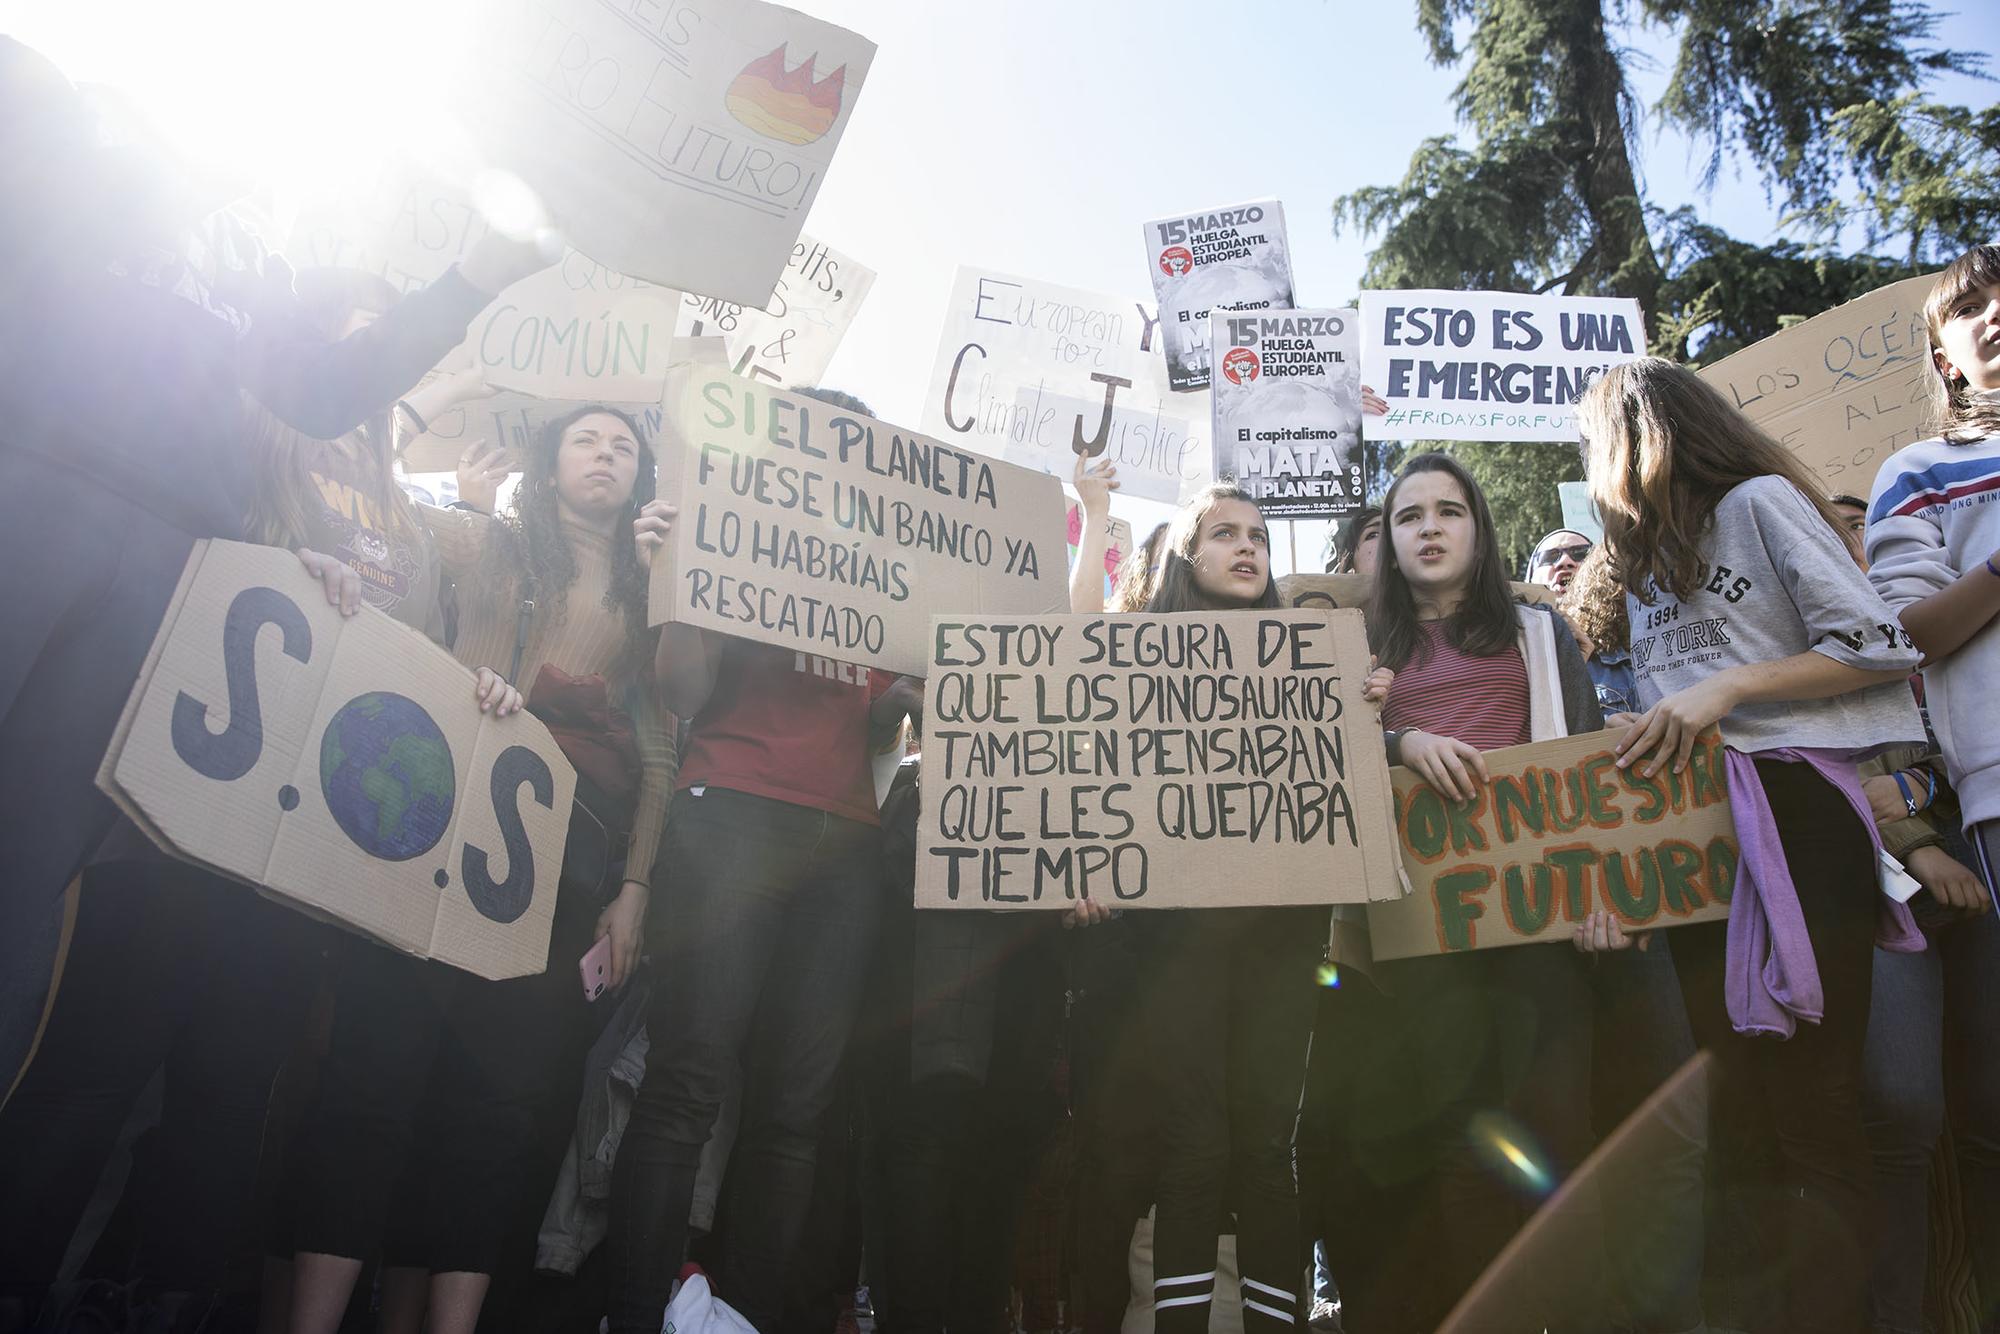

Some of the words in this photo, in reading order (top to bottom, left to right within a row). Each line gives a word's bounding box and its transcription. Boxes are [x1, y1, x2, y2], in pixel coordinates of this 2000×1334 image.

[625, 56, 817, 211] FUTURO!
[1157, 219, 1188, 246] 15
[1187, 206, 1264, 233] MARZO
[1190, 228, 1239, 245] HUELGA
[1191, 234, 1269, 256] ESTUDIANTIL
[1193, 248, 1252, 267] EUROPEA
[974, 277, 1123, 346] European
[1178, 310, 1191, 323] El
[1227, 318, 1258, 346] 15
[1261, 316, 1345, 338] MARZO
[1383, 306, 1476, 348] ESTO
[1492, 309, 1544, 351] ES
[1559, 311, 1635, 354] UNA
[480, 304, 650, 378] COMÚN
[1261, 339, 1316, 351] HUELGA
[1262, 350, 1346, 365] ESTUDIANTIL
[1729, 366, 1800, 409] LOS
[1824, 310, 1927, 373] OCÉA
[1262, 364, 1326, 378] EUROPEA
[1385, 358, 1609, 405] EMERGENC
[944, 342, 1056, 449] Climate
[1071, 371, 1202, 481] Justice
[703, 381, 755, 434] SI
[767, 397, 828, 460] EL
[829, 416, 997, 509] PLANETA
[1238, 428, 1251, 441] El
[1255, 428, 1338, 445] capitalismo
[1238, 445, 1344, 479] MATA
[700, 442, 823, 517] FUESE
[833, 480, 885, 537] UN
[890, 501, 992, 566] BANCO
[1004, 535, 1040, 580] YA
[1261, 479, 1346, 499] PLANETA
[695, 503, 741, 558] LO
[751, 518, 910, 602] HABRÍAIS
[686, 568, 885, 655] RESCATADO
[1647, 602, 1679, 629] 1994
[934, 622, 1064, 668] ESTOY
[1080, 619, 1233, 671] SEGURA
[1257, 619, 1336, 671] DE
[1661, 617, 1731, 657] YORK
[1687, 651, 1722, 665] FOREVER
[935, 672, 1022, 724] QUE
[1034, 672, 1118, 724] LOS
[1128, 672, 1343, 724] DINOSAURIOS
[934, 728, 1119, 780] TAMBIEN
[1127, 724, 1347, 782] PENSABAN
[939, 783, 1026, 842] QUE
[1039, 782, 1136, 841] LES
[1156, 781, 1359, 848] QUEDABA
[1394, 774, 1491, 865] OR
[929, 842, 1149, 902] TIEMPO
[1431, 834, 1742, 953] FUTURO
